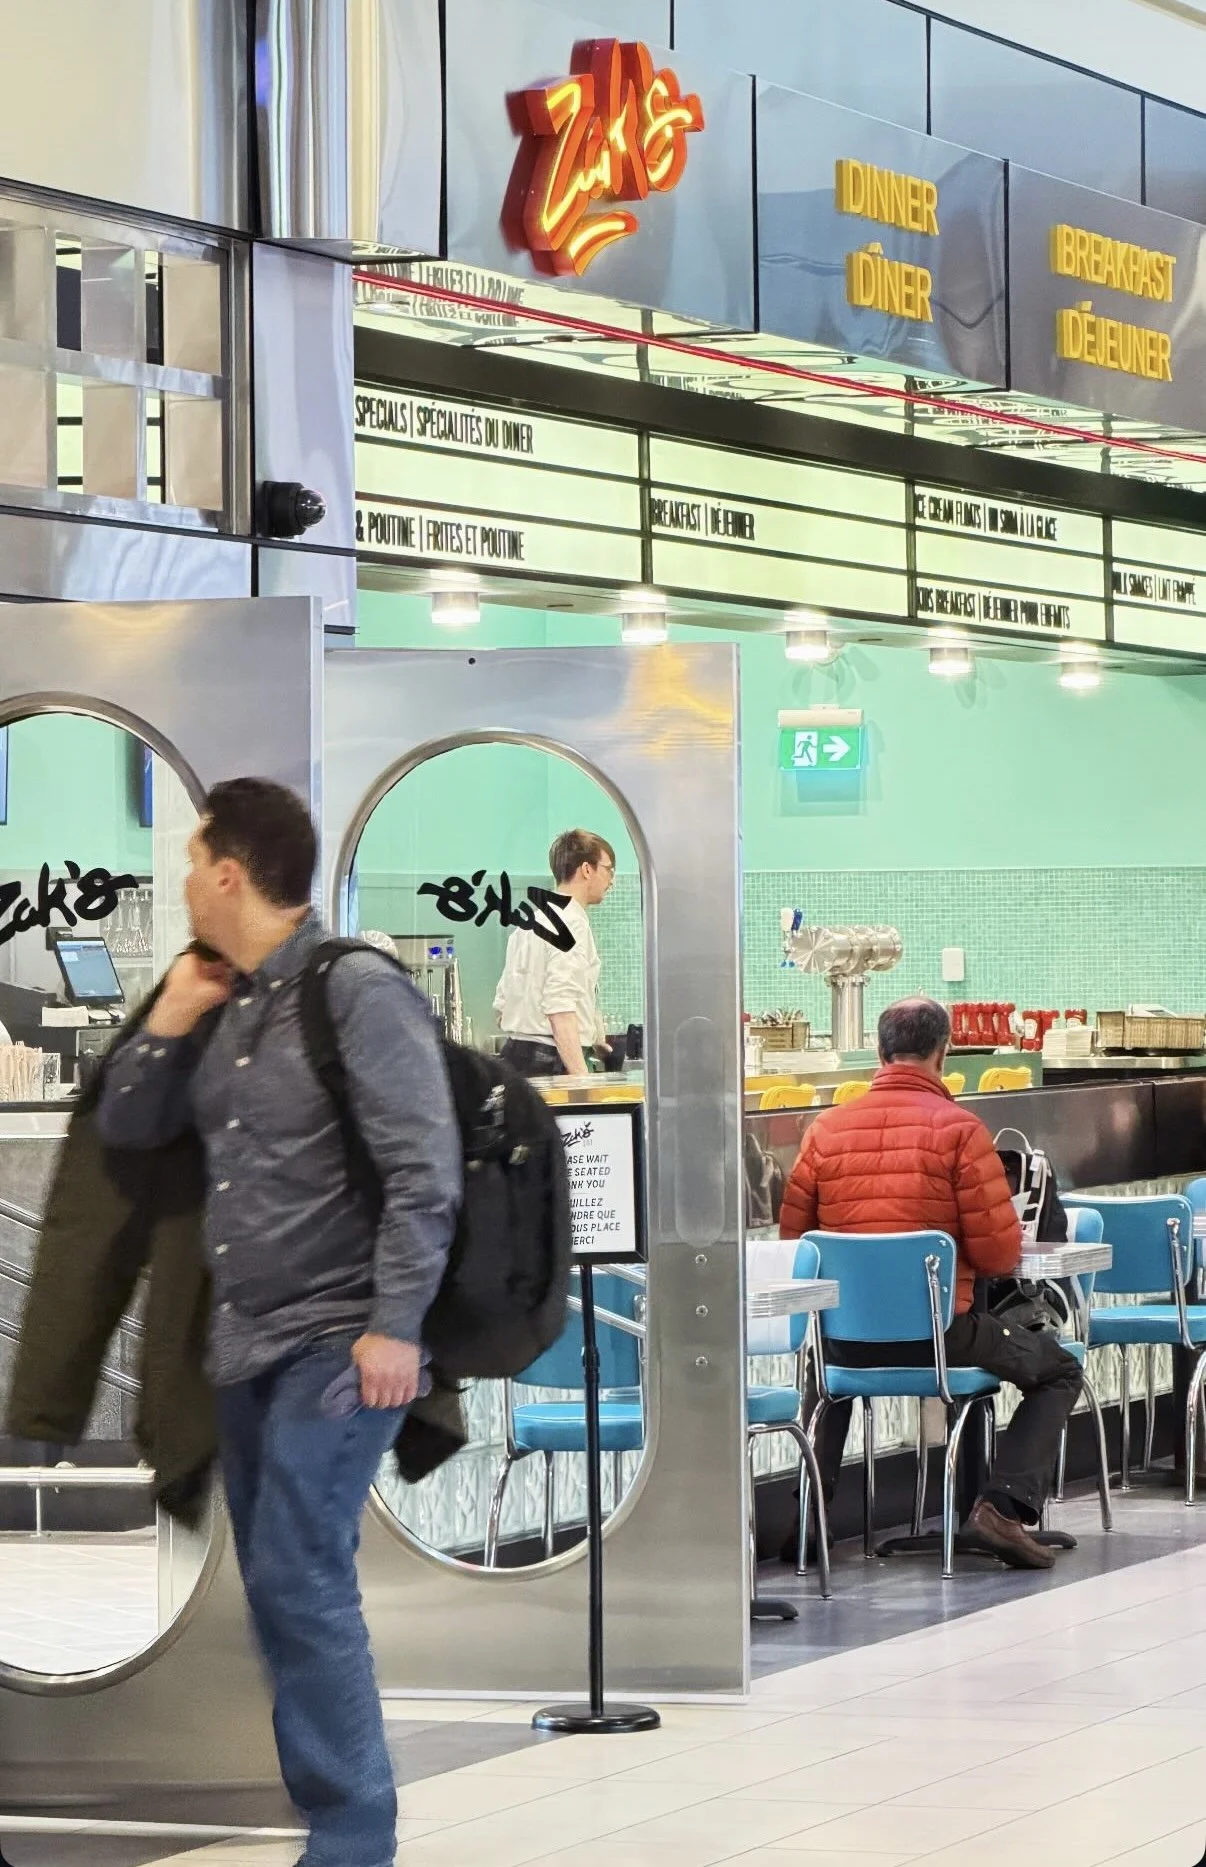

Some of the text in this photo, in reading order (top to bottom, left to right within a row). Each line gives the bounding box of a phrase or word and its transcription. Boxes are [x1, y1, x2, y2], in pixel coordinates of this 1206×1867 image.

[834, 159, 939, 236] DINNER
[1053, 224, 1177, 302] BREAKFAST
[847, 242, 933, 322] DÎNER
[1057, 300, 1172, 381] DÉJEUNER
[355, 394, 408, 434] SPECIALS
[416, 401, 482, 446] SPÉCIALITÉS
[485, 417, 498, 448] DU
[650, 498, 700, 532] BREAKFAST
[355, 510, 365, 542] &
[368, 511, 416, 548] POUTINE
[427, 519, 462, 553] FRITES
[465, 523, 477, 555] ET
[480, 526, 525, 561] POUTINE
[575, 1167, 610, 1177] SEATED
[587, 1154, 608, 1163] WAIT
[587, 1180, 605, 1189] YOU
[571, 1223, 621, 1232] OUS PLACE
[597, 1210, 616, 1220] QUE
[572, 1236, 594, 1245] ERCI
